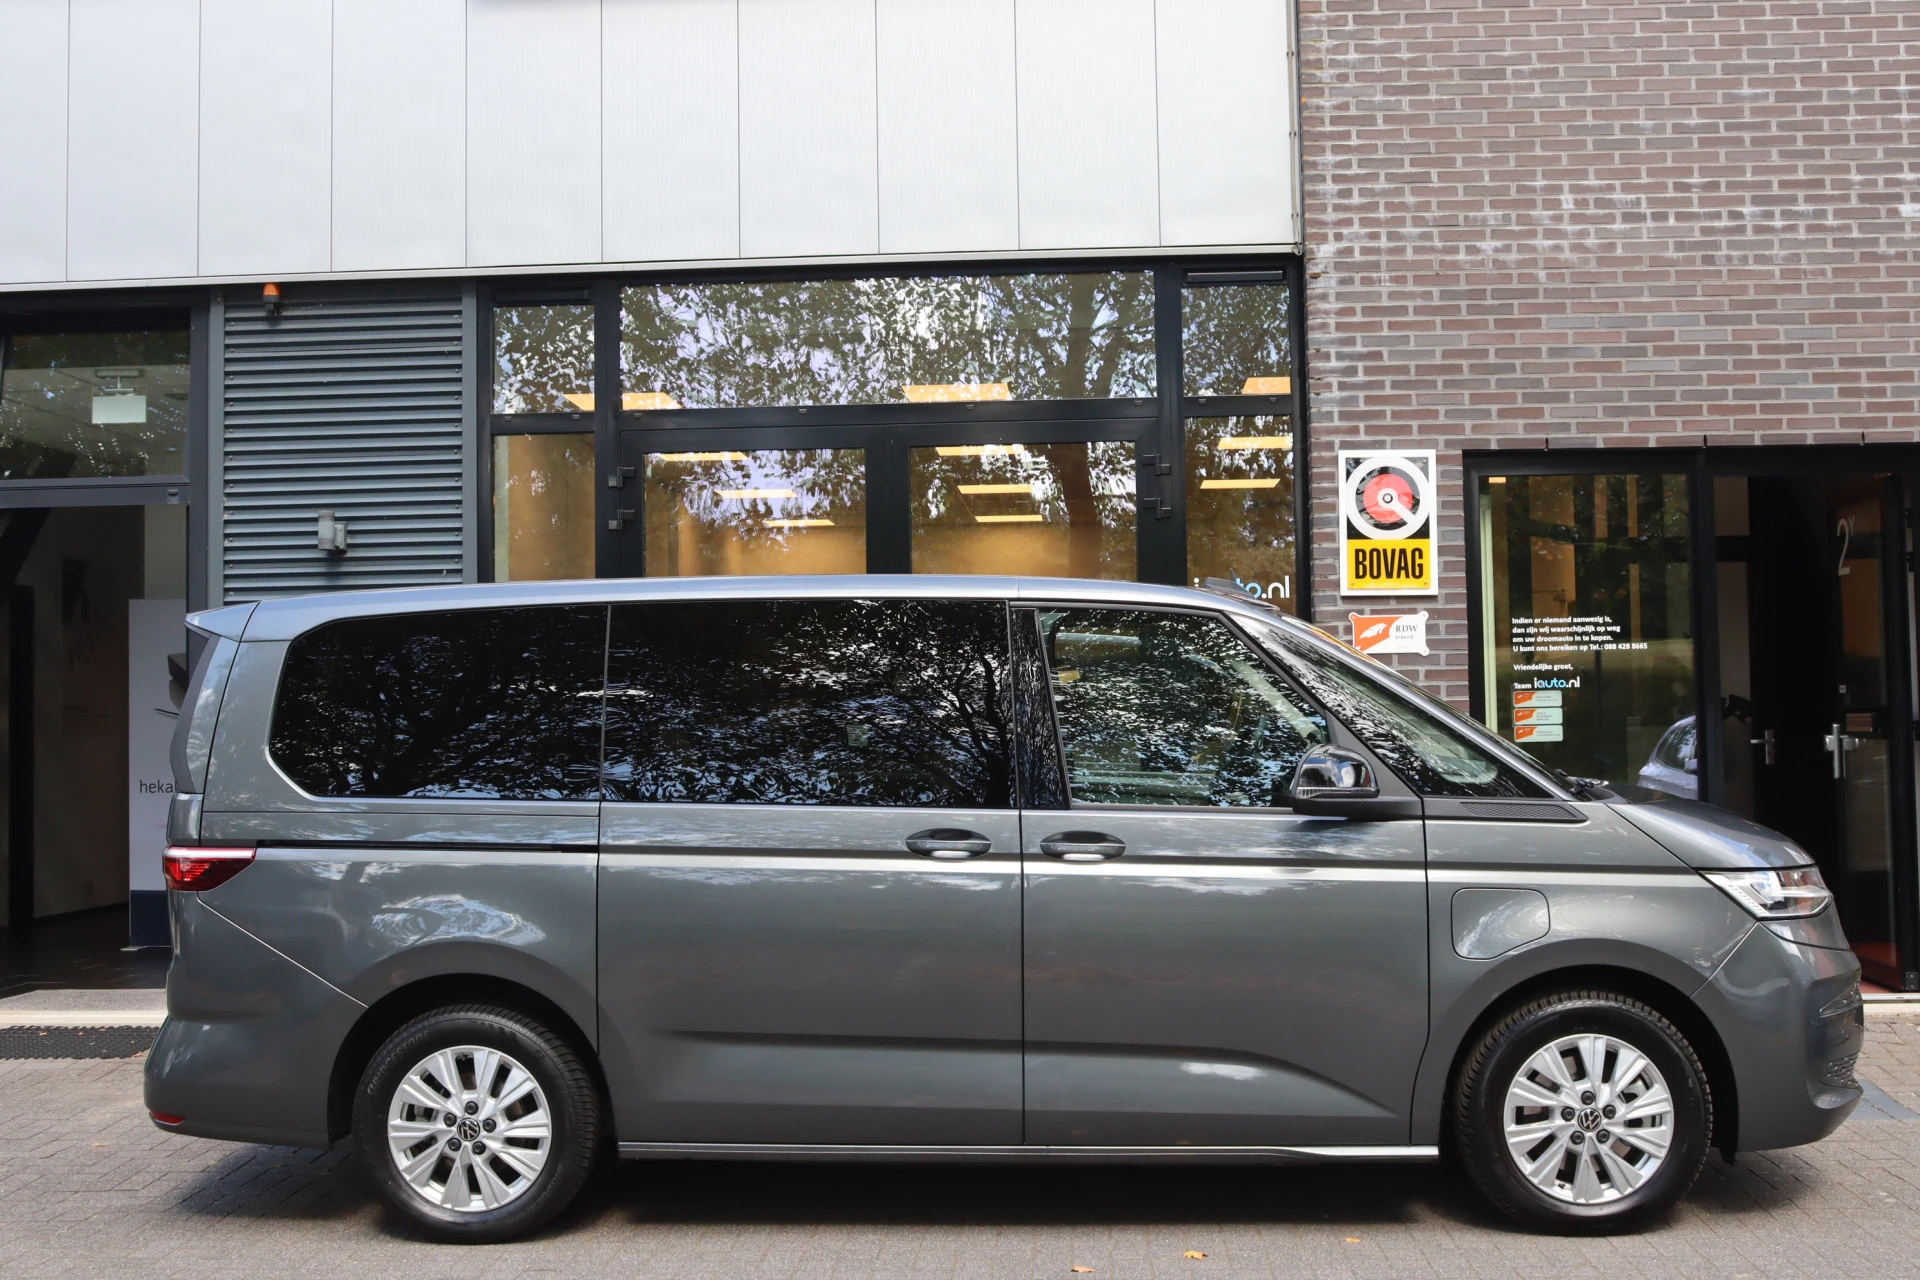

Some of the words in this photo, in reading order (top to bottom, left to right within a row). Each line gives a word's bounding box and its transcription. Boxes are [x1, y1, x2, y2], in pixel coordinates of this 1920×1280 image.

[1354, 547, 1424, 580] BOVAG
[1193, 575, 1290, 600] io.nl
[1542, 616, 1572, 624] niemand
[1573, 616, 1603, 624] aanwezig
[1395, 624, 1419, 633] RDW
[1526, 627, 1538, 635] zijn
[1538, 626, 1550, 634] wij
[1550, 625, 1595, 633] waarschijnlijk
[1574, 634, 1582, 642] in
[1590, 634, 1614, 642] kopen.
[1589, 643, 1603, 651] Tel.:
[1631, 642, 1648, 650] 8665
[1513, 663, 1553, 671] Vriendelijke
[1553, 663, 1574, 671] groet,
[1533, 676, 1581, 689] iauto.nl
[139, 779, 176, 794] heka
